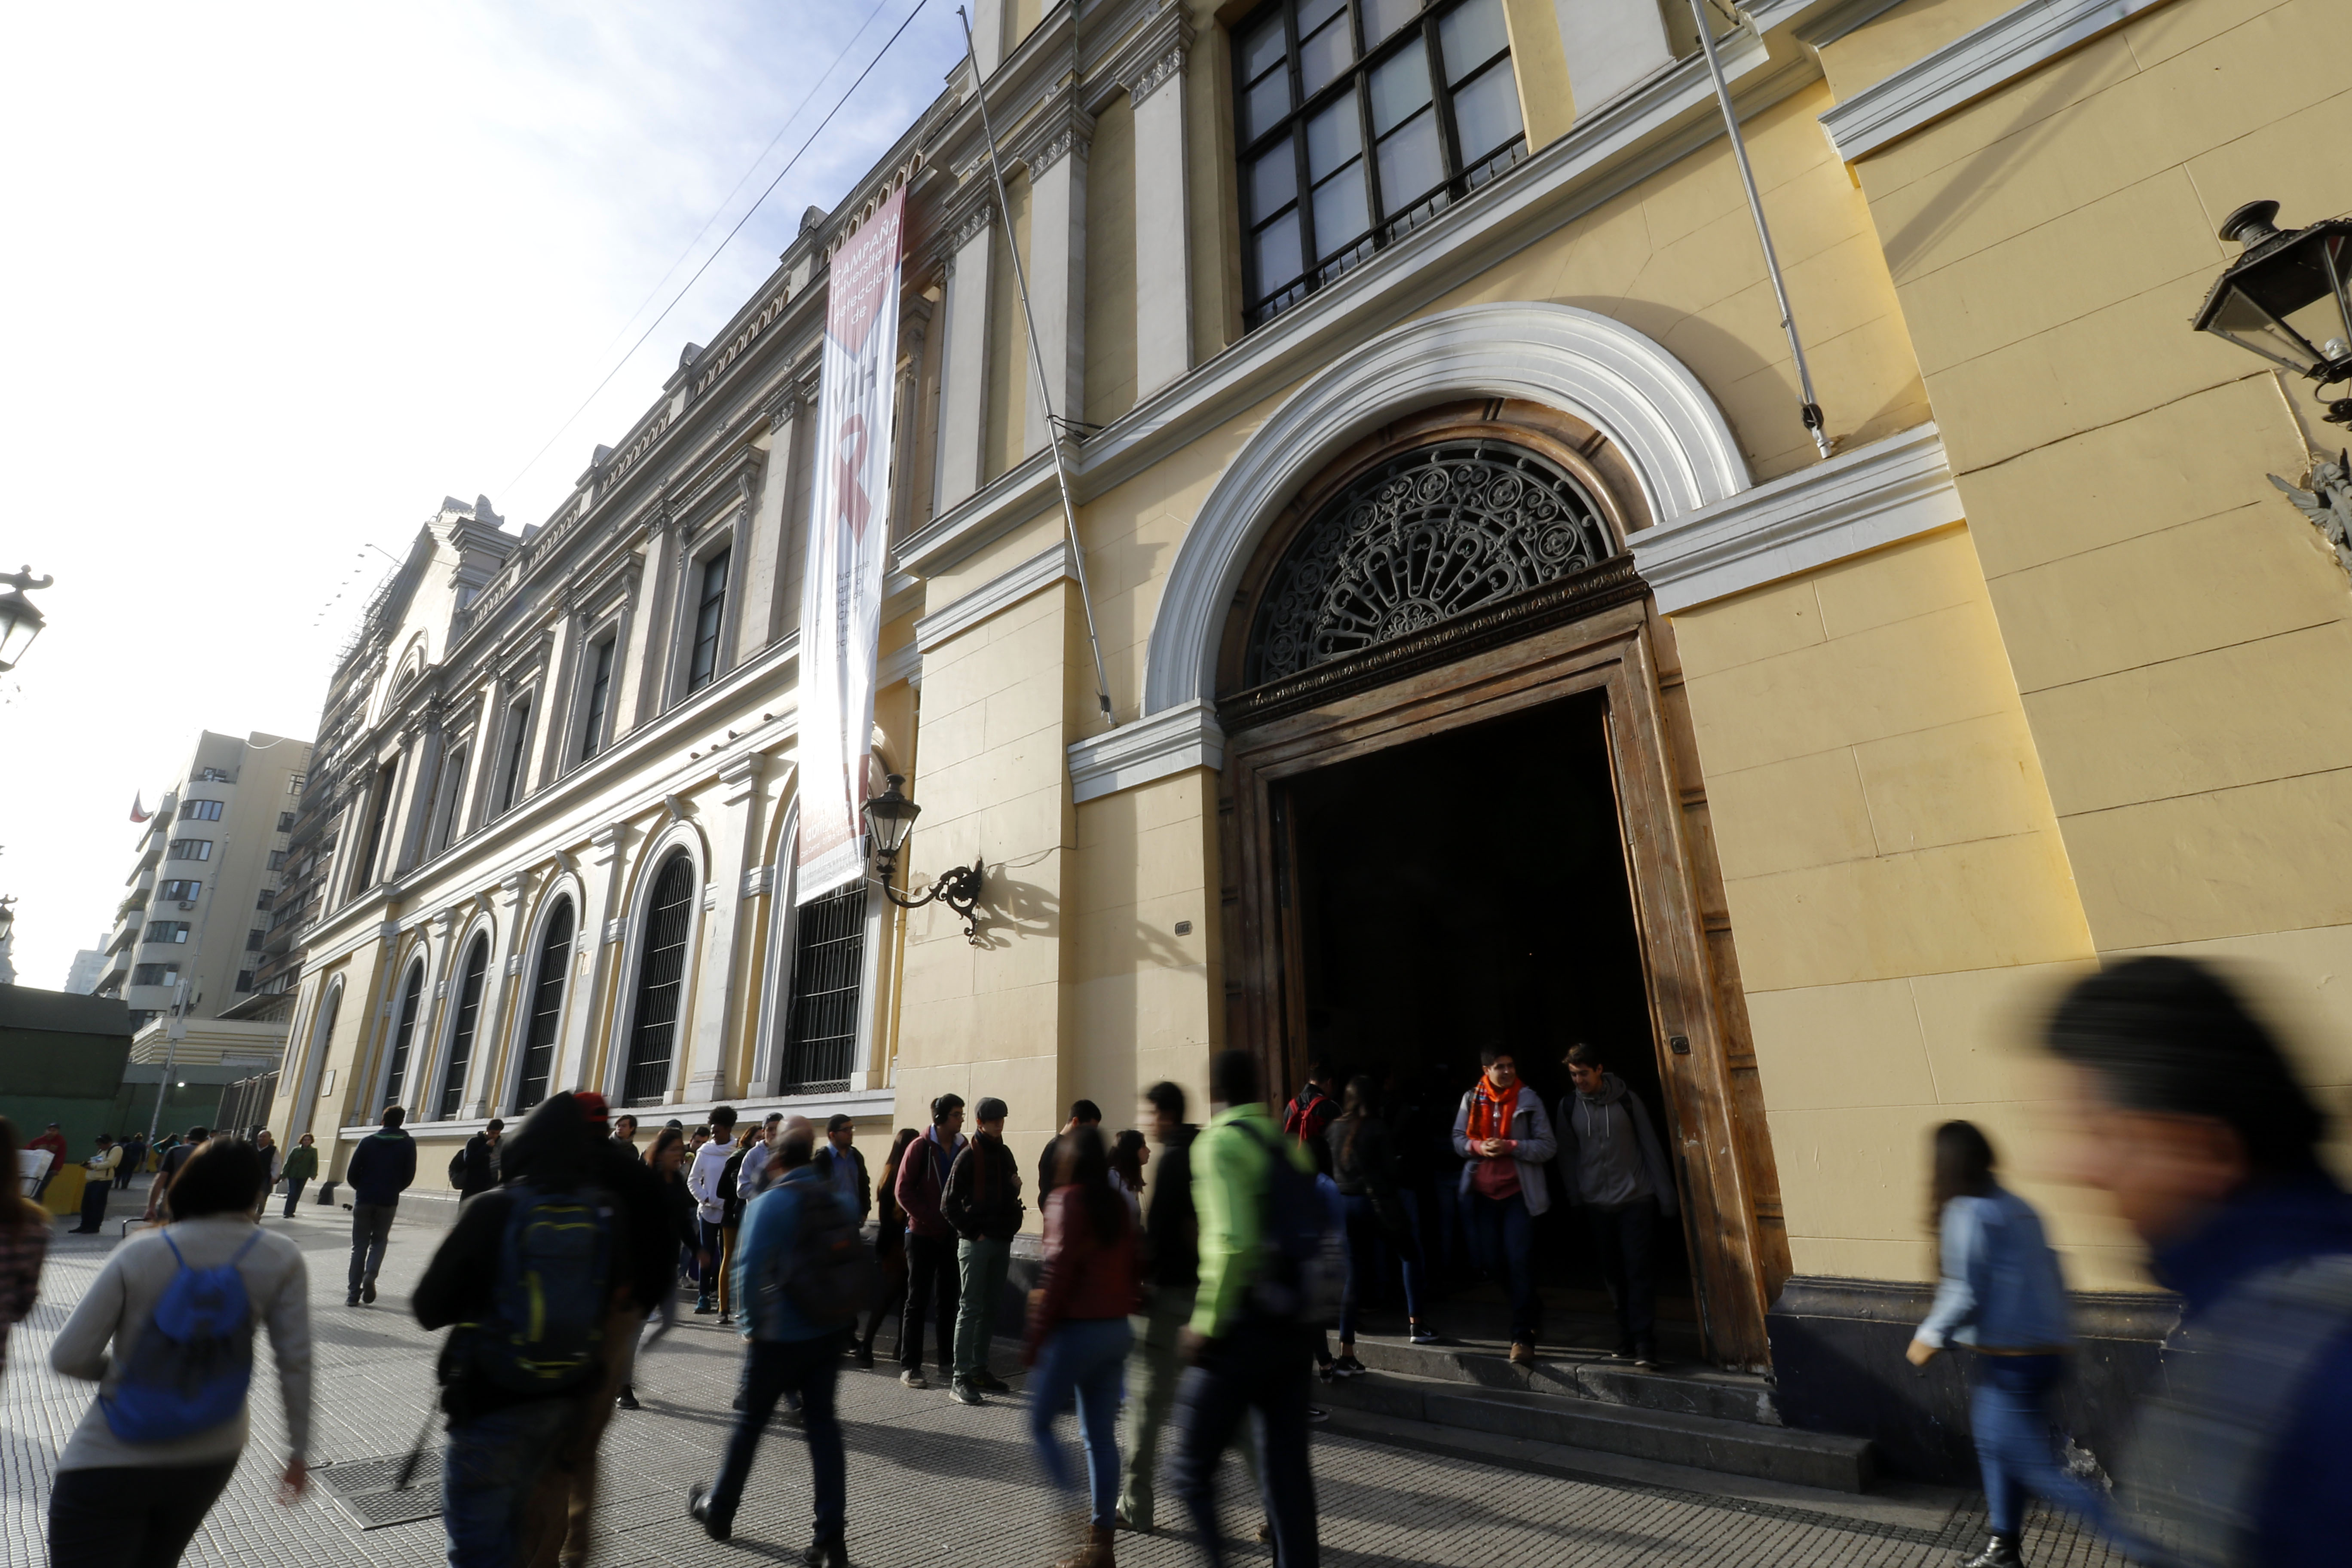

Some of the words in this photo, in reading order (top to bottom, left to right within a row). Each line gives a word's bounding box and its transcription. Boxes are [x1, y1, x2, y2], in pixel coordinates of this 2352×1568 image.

[832, 231, 898, 305] universitaria
[833, 213, 900, 287] CAMPAÑA
[834, 264, 891, 324] detección
[851, 306, 867, 325] de
